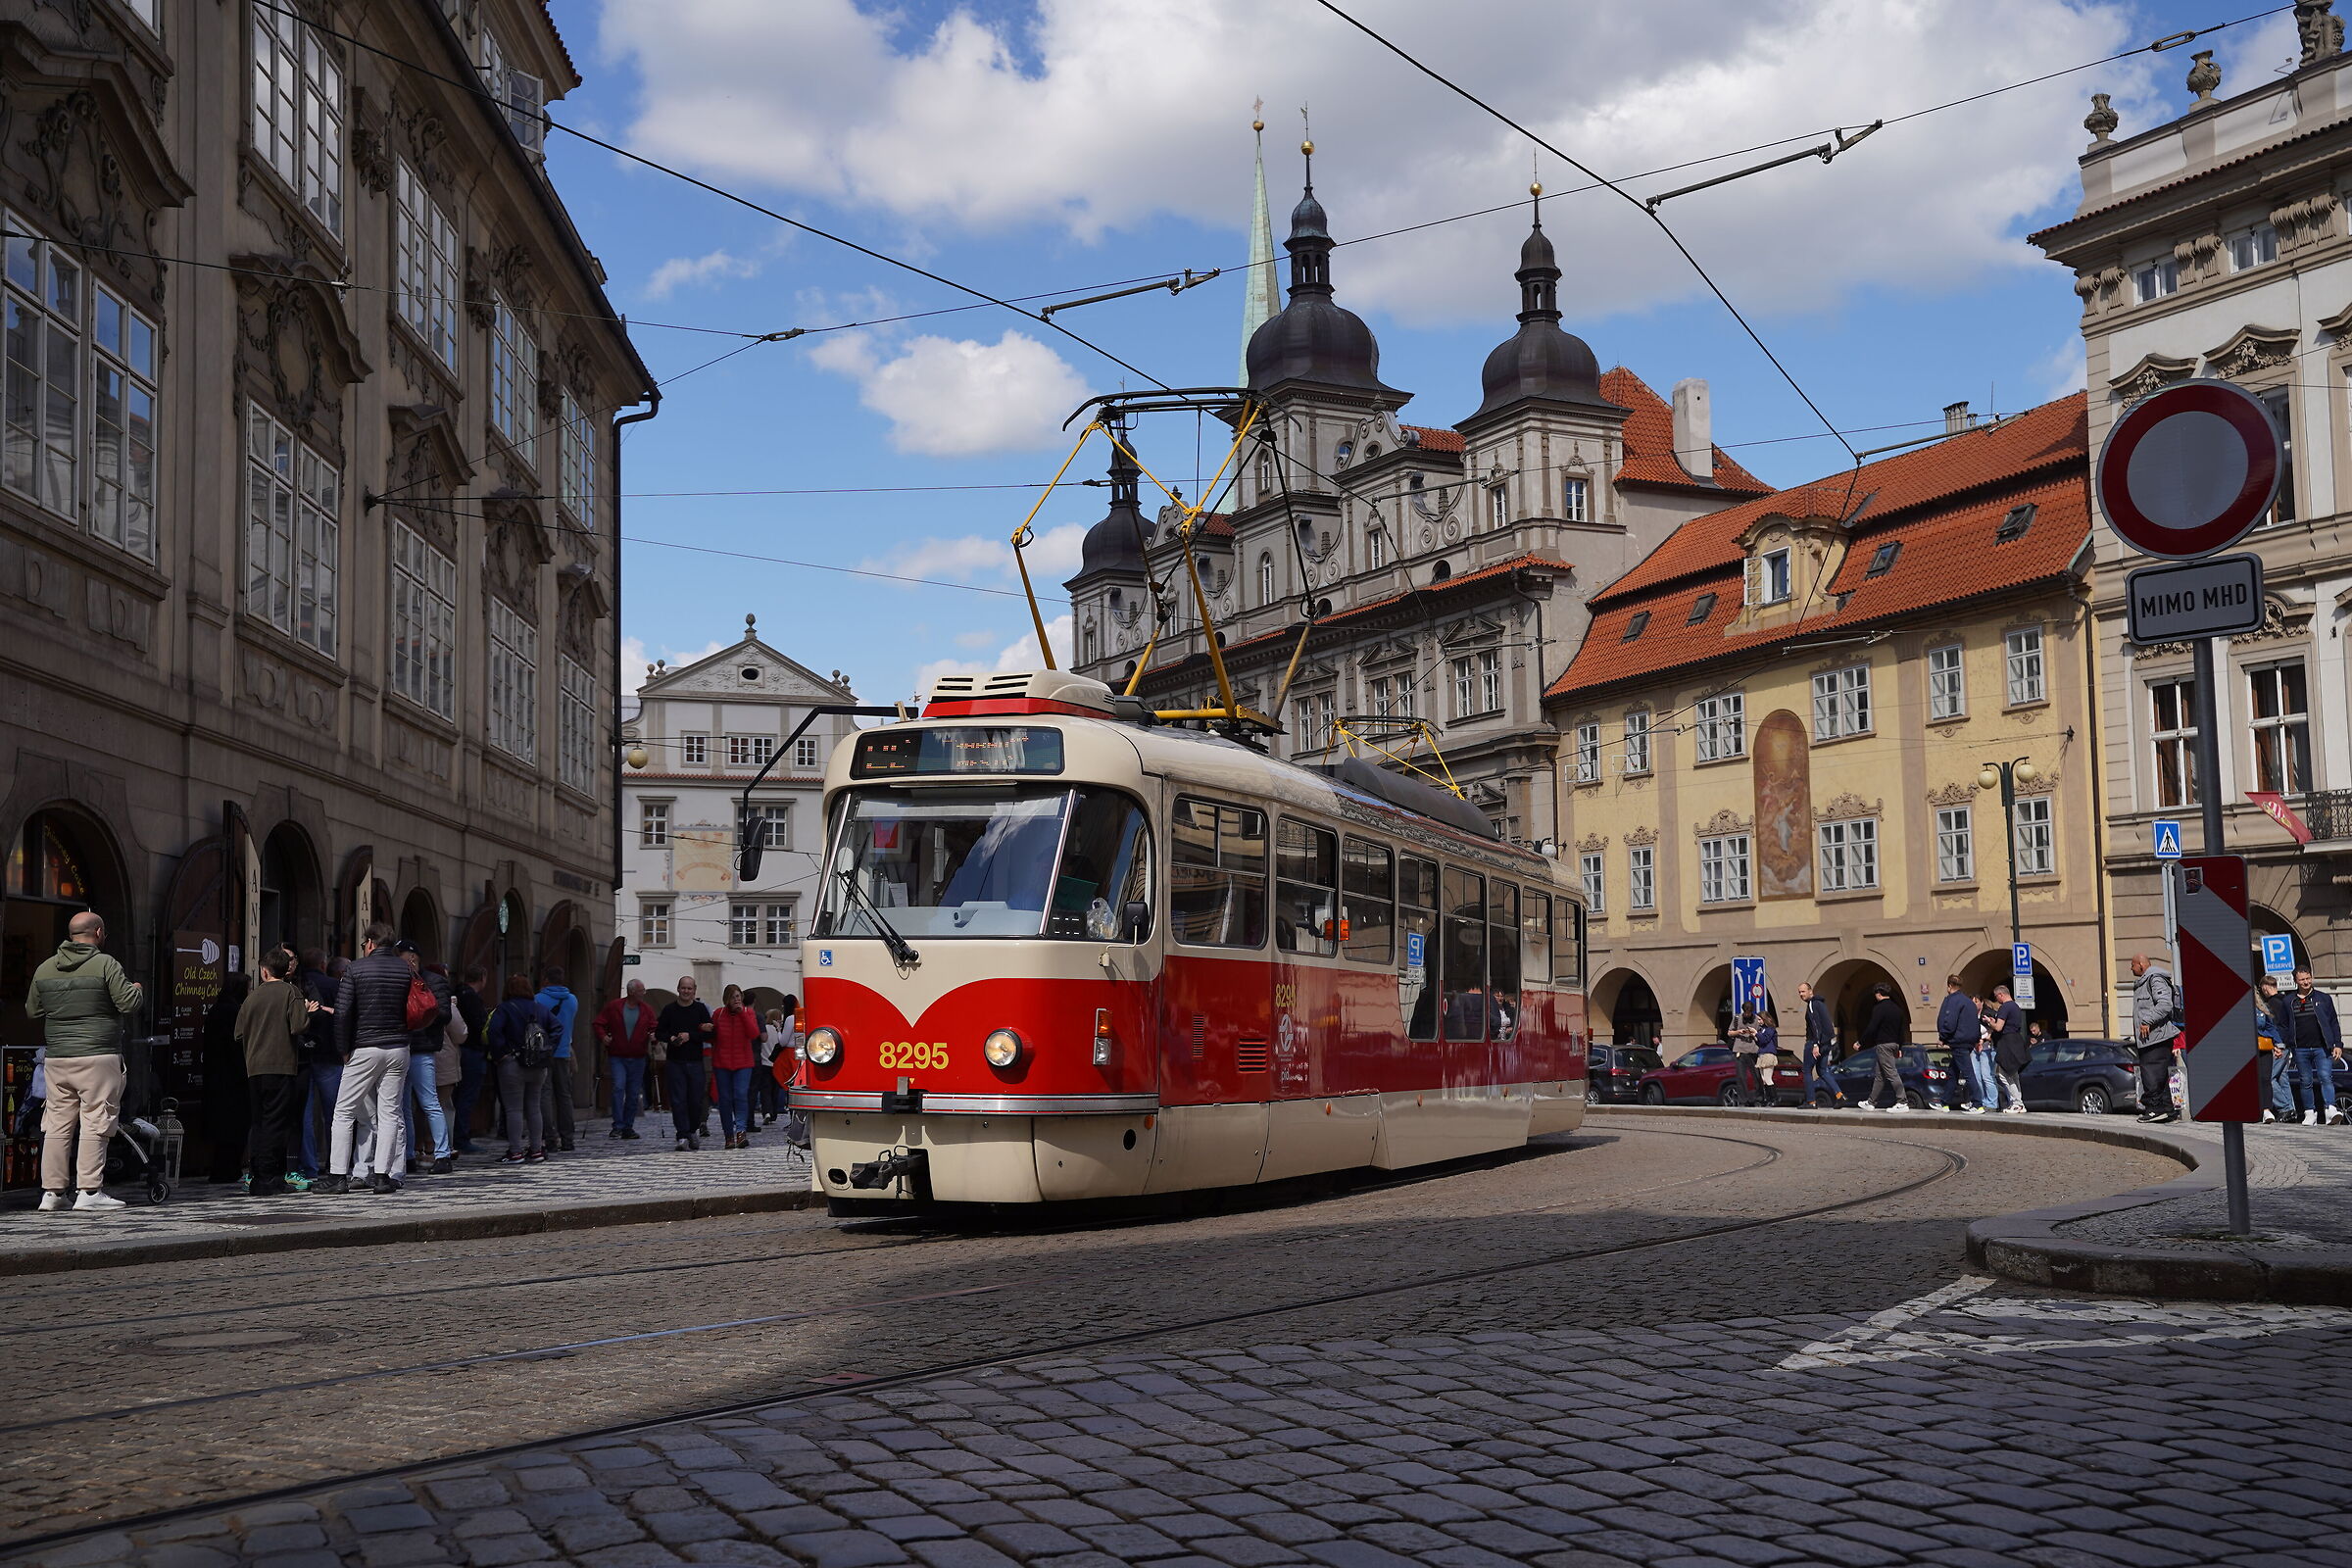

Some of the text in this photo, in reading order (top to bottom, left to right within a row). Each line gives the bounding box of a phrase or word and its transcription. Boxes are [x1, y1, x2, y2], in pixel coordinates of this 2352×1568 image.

[2140, 583, 2247, 618] MIMO MHD
[2016, 946, 2028, 966] P
[2268, 940, 2285, 962] P
[183, 966, 218, 981] Old Czech
[174, 982, 206, 1000] Chimney
[1275, 984, 1297, 1007] 8295
[879, 1042, 950, 1069] 8295
